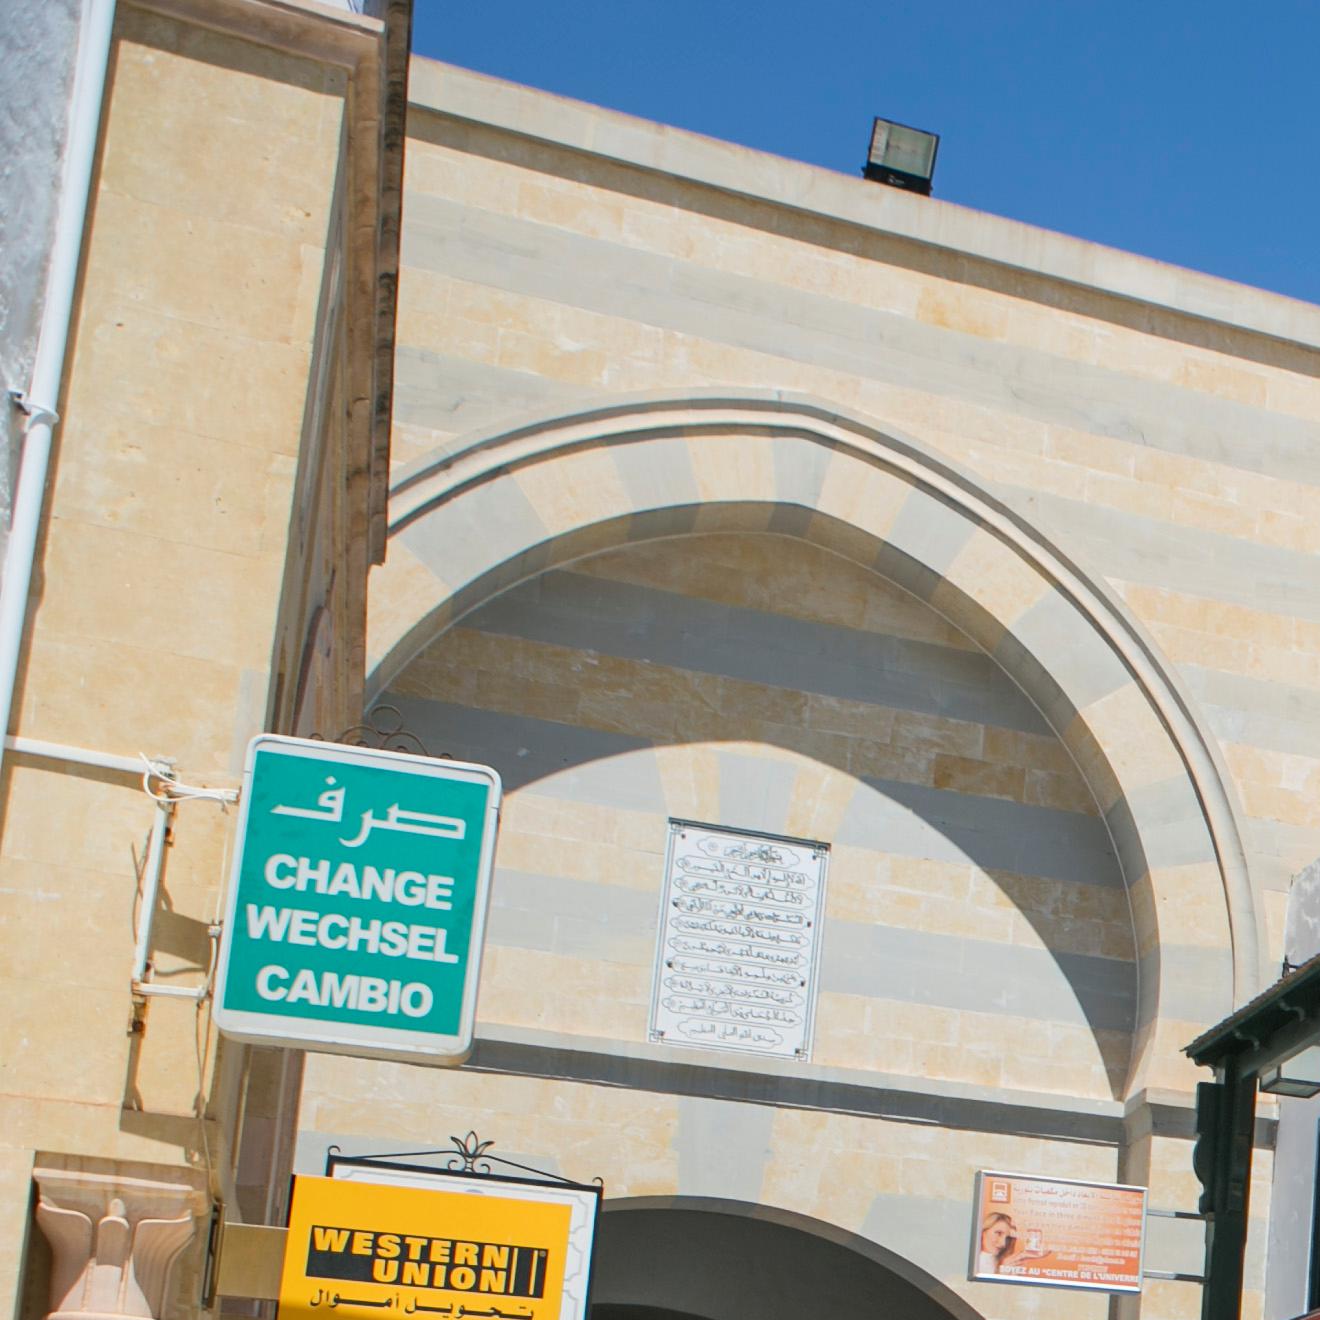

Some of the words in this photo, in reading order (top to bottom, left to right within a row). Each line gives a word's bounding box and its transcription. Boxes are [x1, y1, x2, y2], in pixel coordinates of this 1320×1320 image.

[269, 775, 467, 848] صرف
[264, 853, 455, 911] CHANGE
[246, 903, 459, 964] WECHSEL
[255, 964, 434, 1018] CAMBIO
[313, 1227, 510, 1269] WESTERN
[310, 1288, 399, 1311] أموال
[372, 1258, 507, 1293] UNION
[404, 1296, 534, 1320] تحويل
